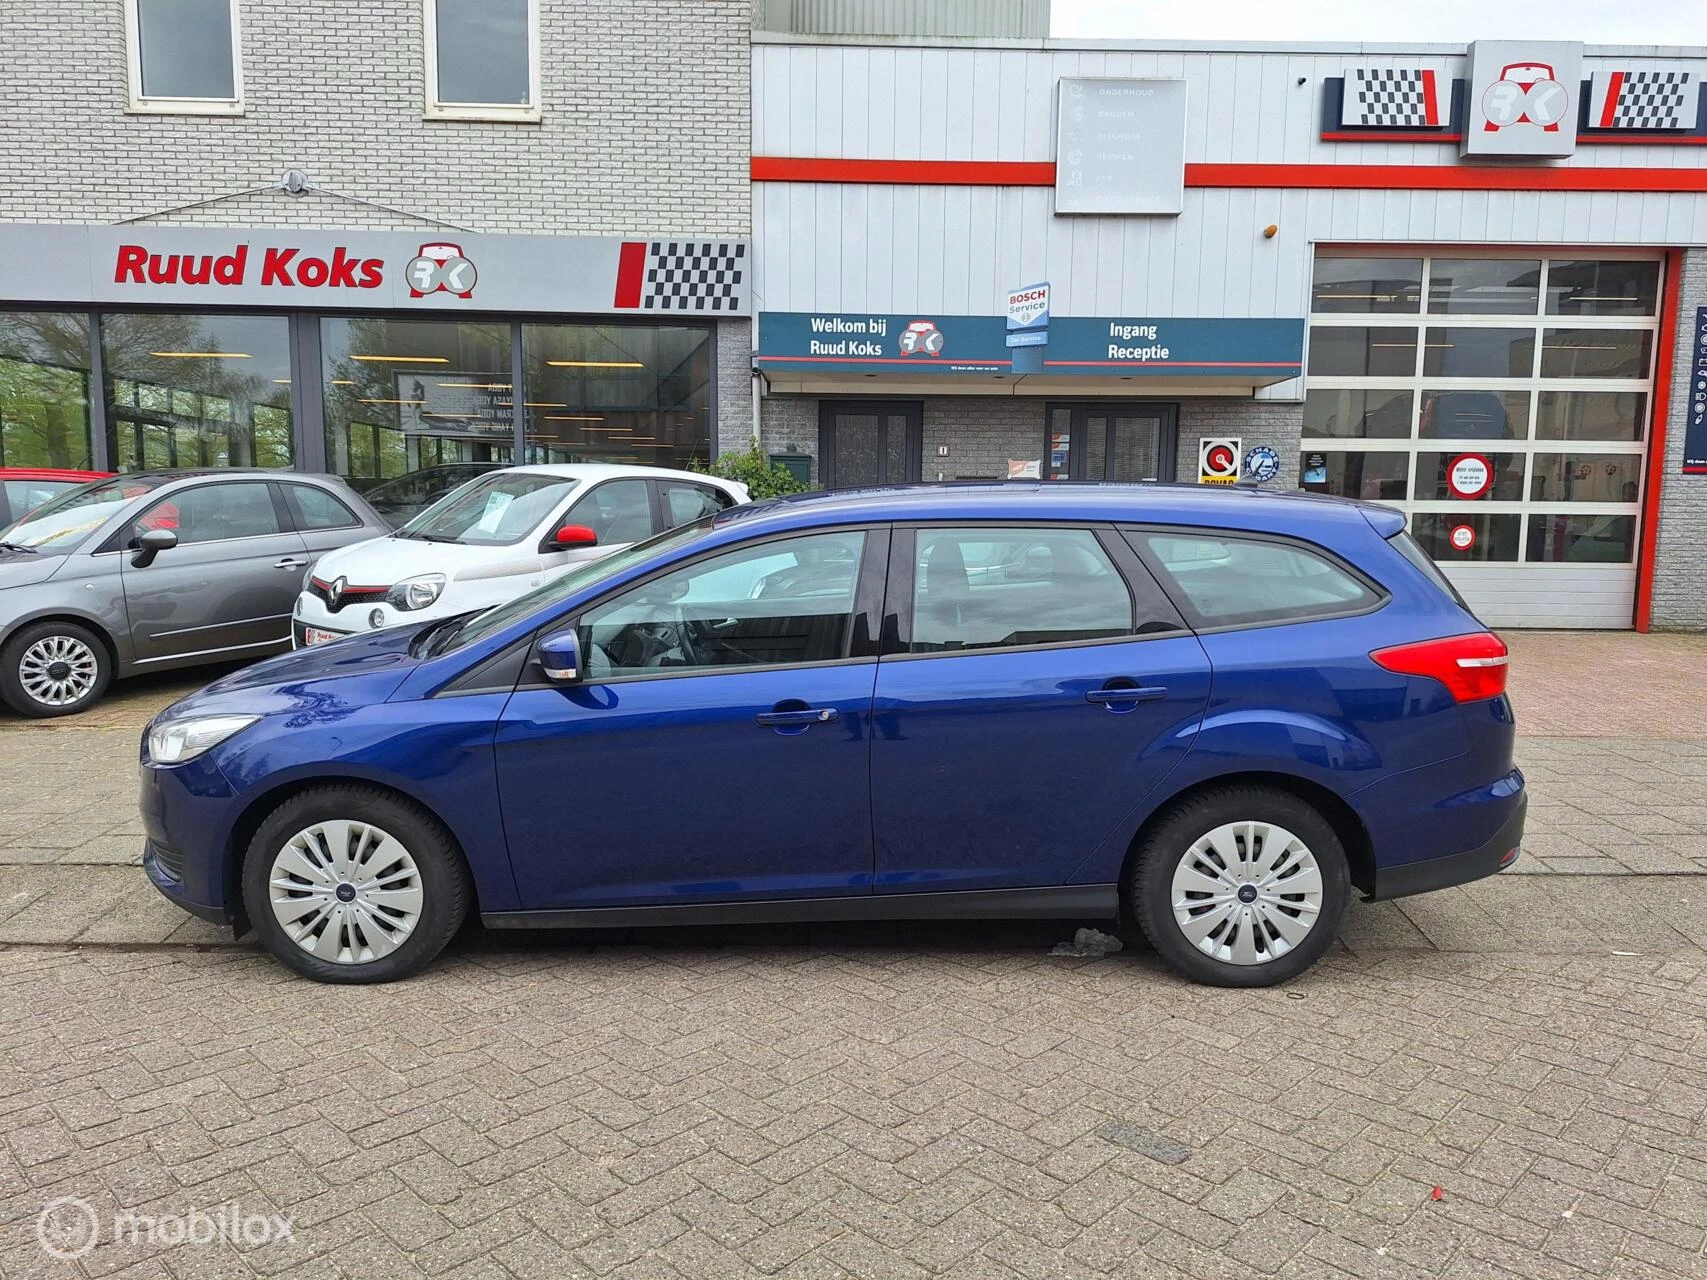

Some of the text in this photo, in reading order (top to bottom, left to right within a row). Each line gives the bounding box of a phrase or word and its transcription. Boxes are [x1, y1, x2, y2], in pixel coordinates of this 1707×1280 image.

[1099, 88, 1155, 97] ONDERHOUD
[114, 245, 249, 285] Ruud
[261, 247, 385, 288] Koks
[1010, 289, 1046, 304] BOSCH
[1009, 302, 1046, 313] Service
[811, 317, 887, 337] Welkom bij
[1109, 322, 1158, 340] Ingang
[810, 340, 882, 356] Ruud Koks
[1108, 344, 1170, 362] Receptie
[1246, 447, 1278, 463] SCHADE
